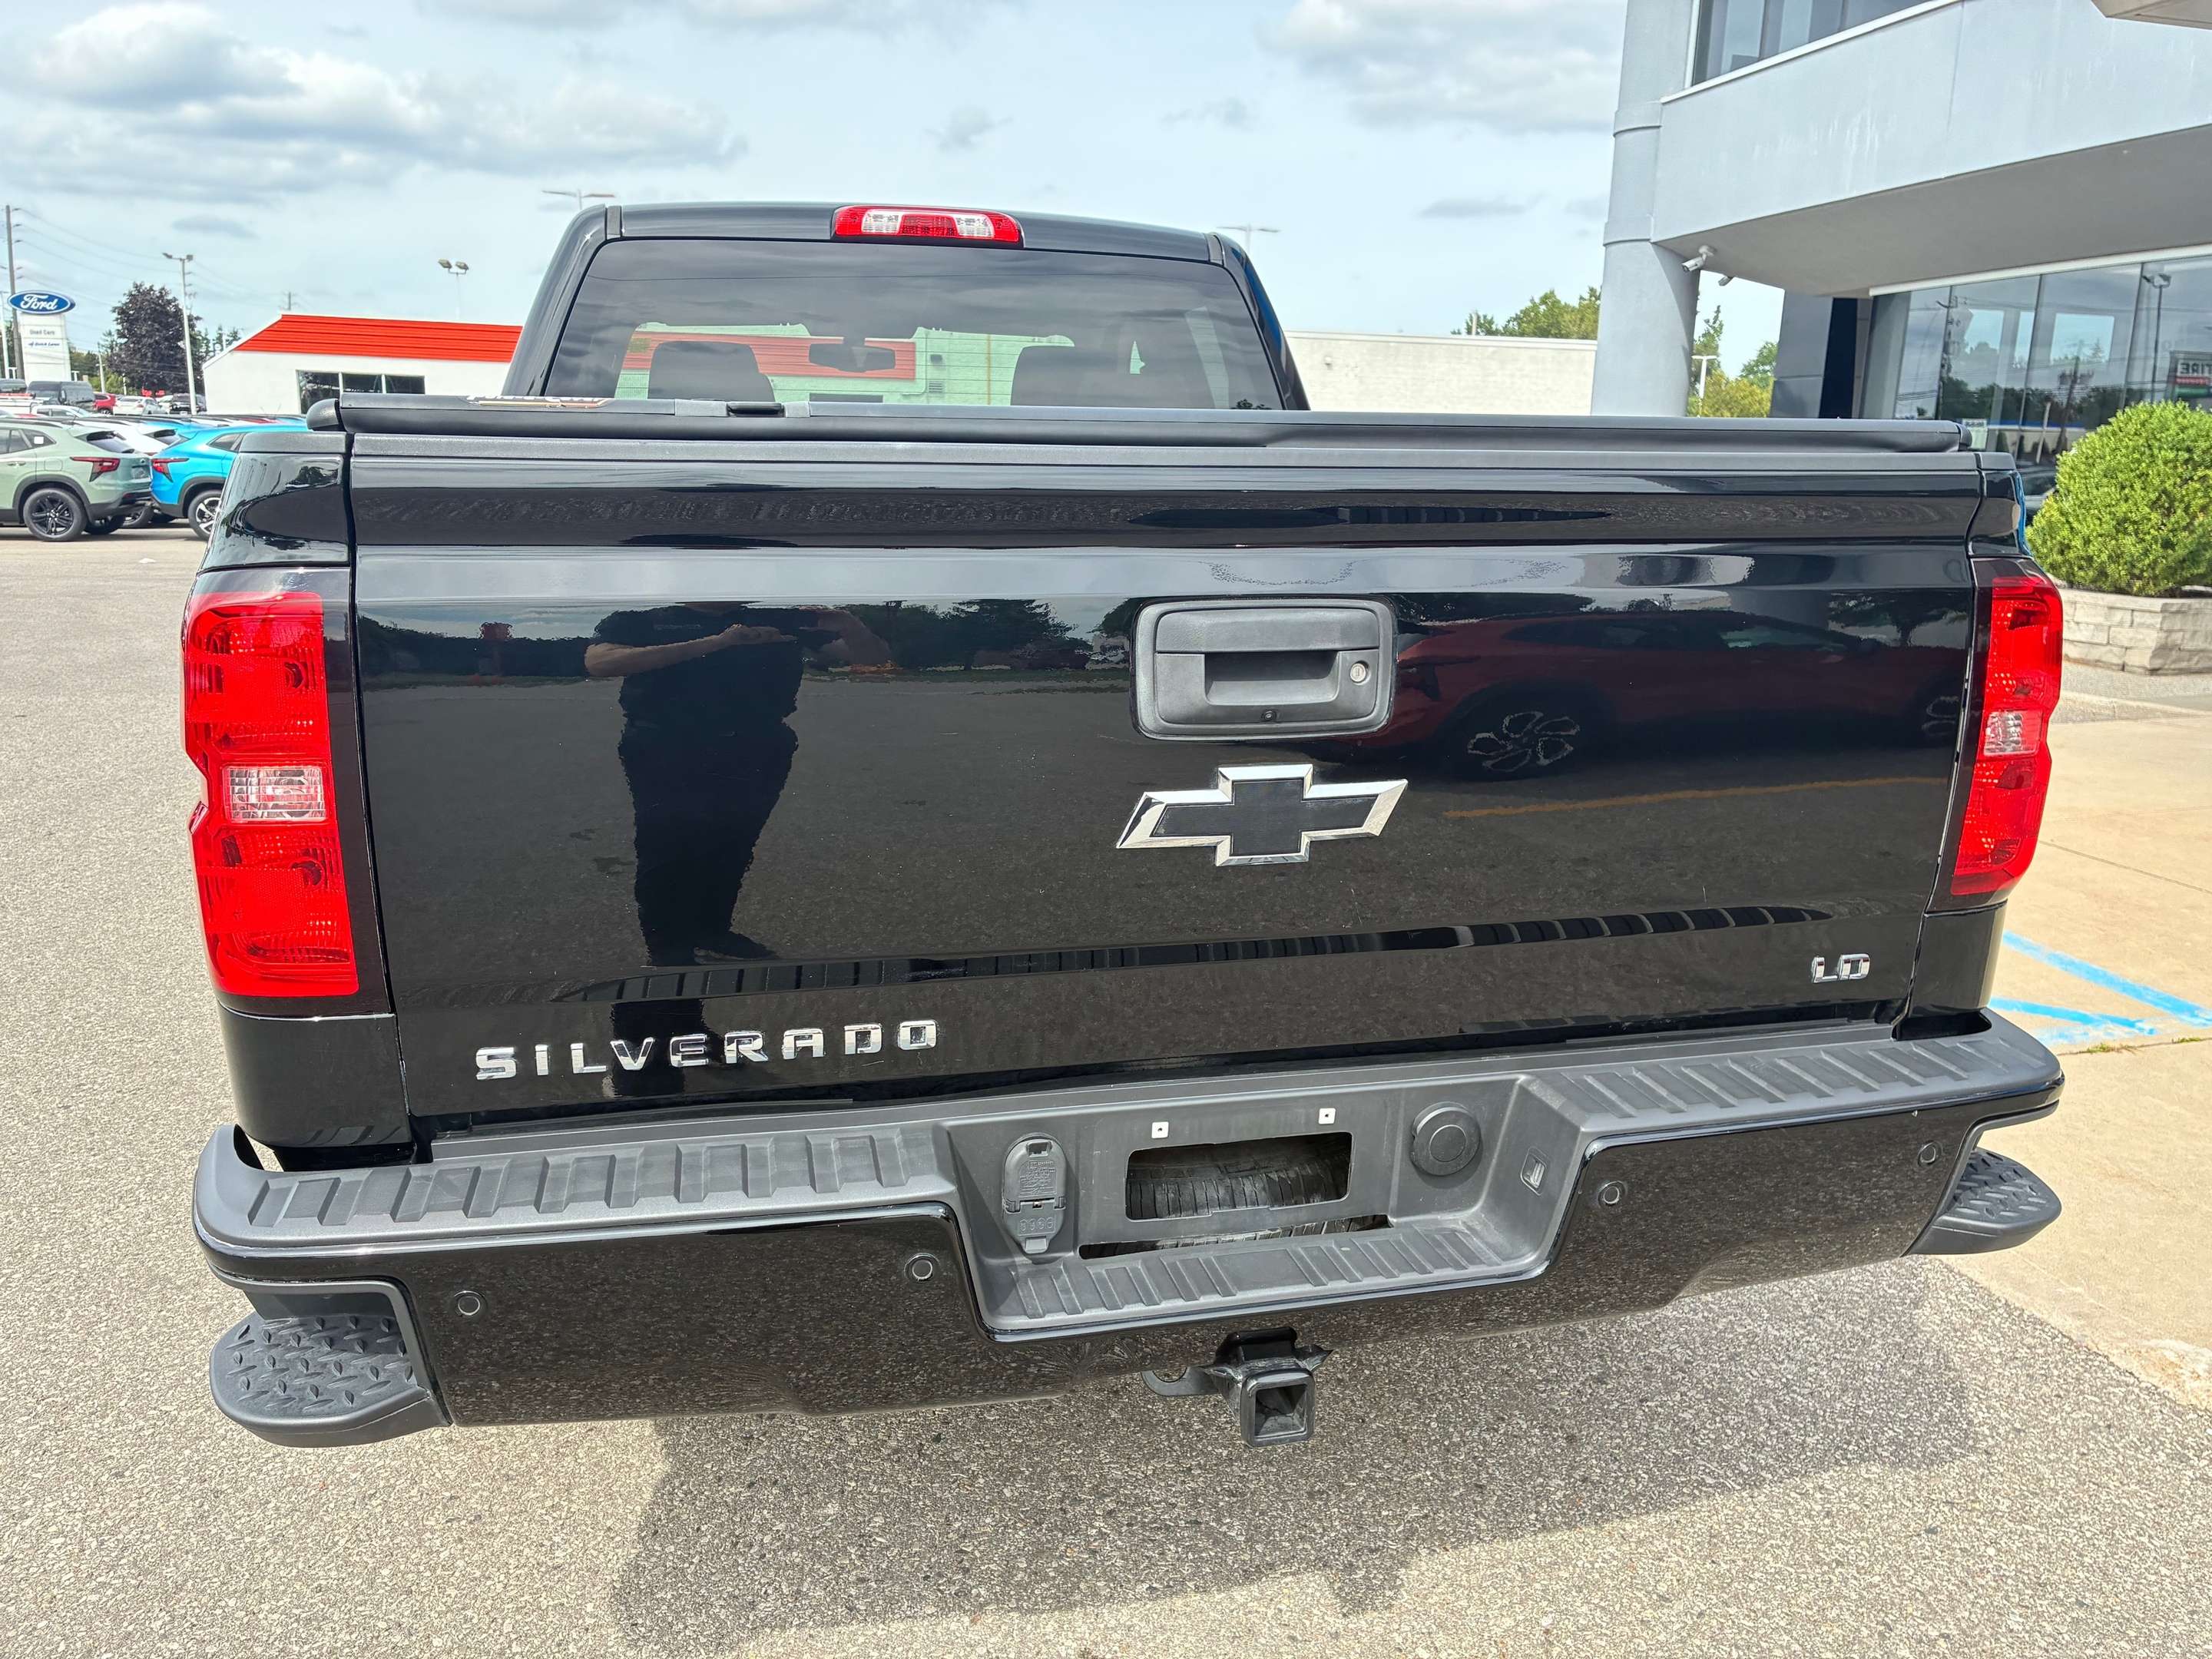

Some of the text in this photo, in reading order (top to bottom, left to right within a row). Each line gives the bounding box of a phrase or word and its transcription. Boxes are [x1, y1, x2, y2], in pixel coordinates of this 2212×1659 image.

[20, 293, 58, 310] Ford
[1810, 953, 1871, 984] LD
[475, 1018, 939, 1081] SILVERADO
